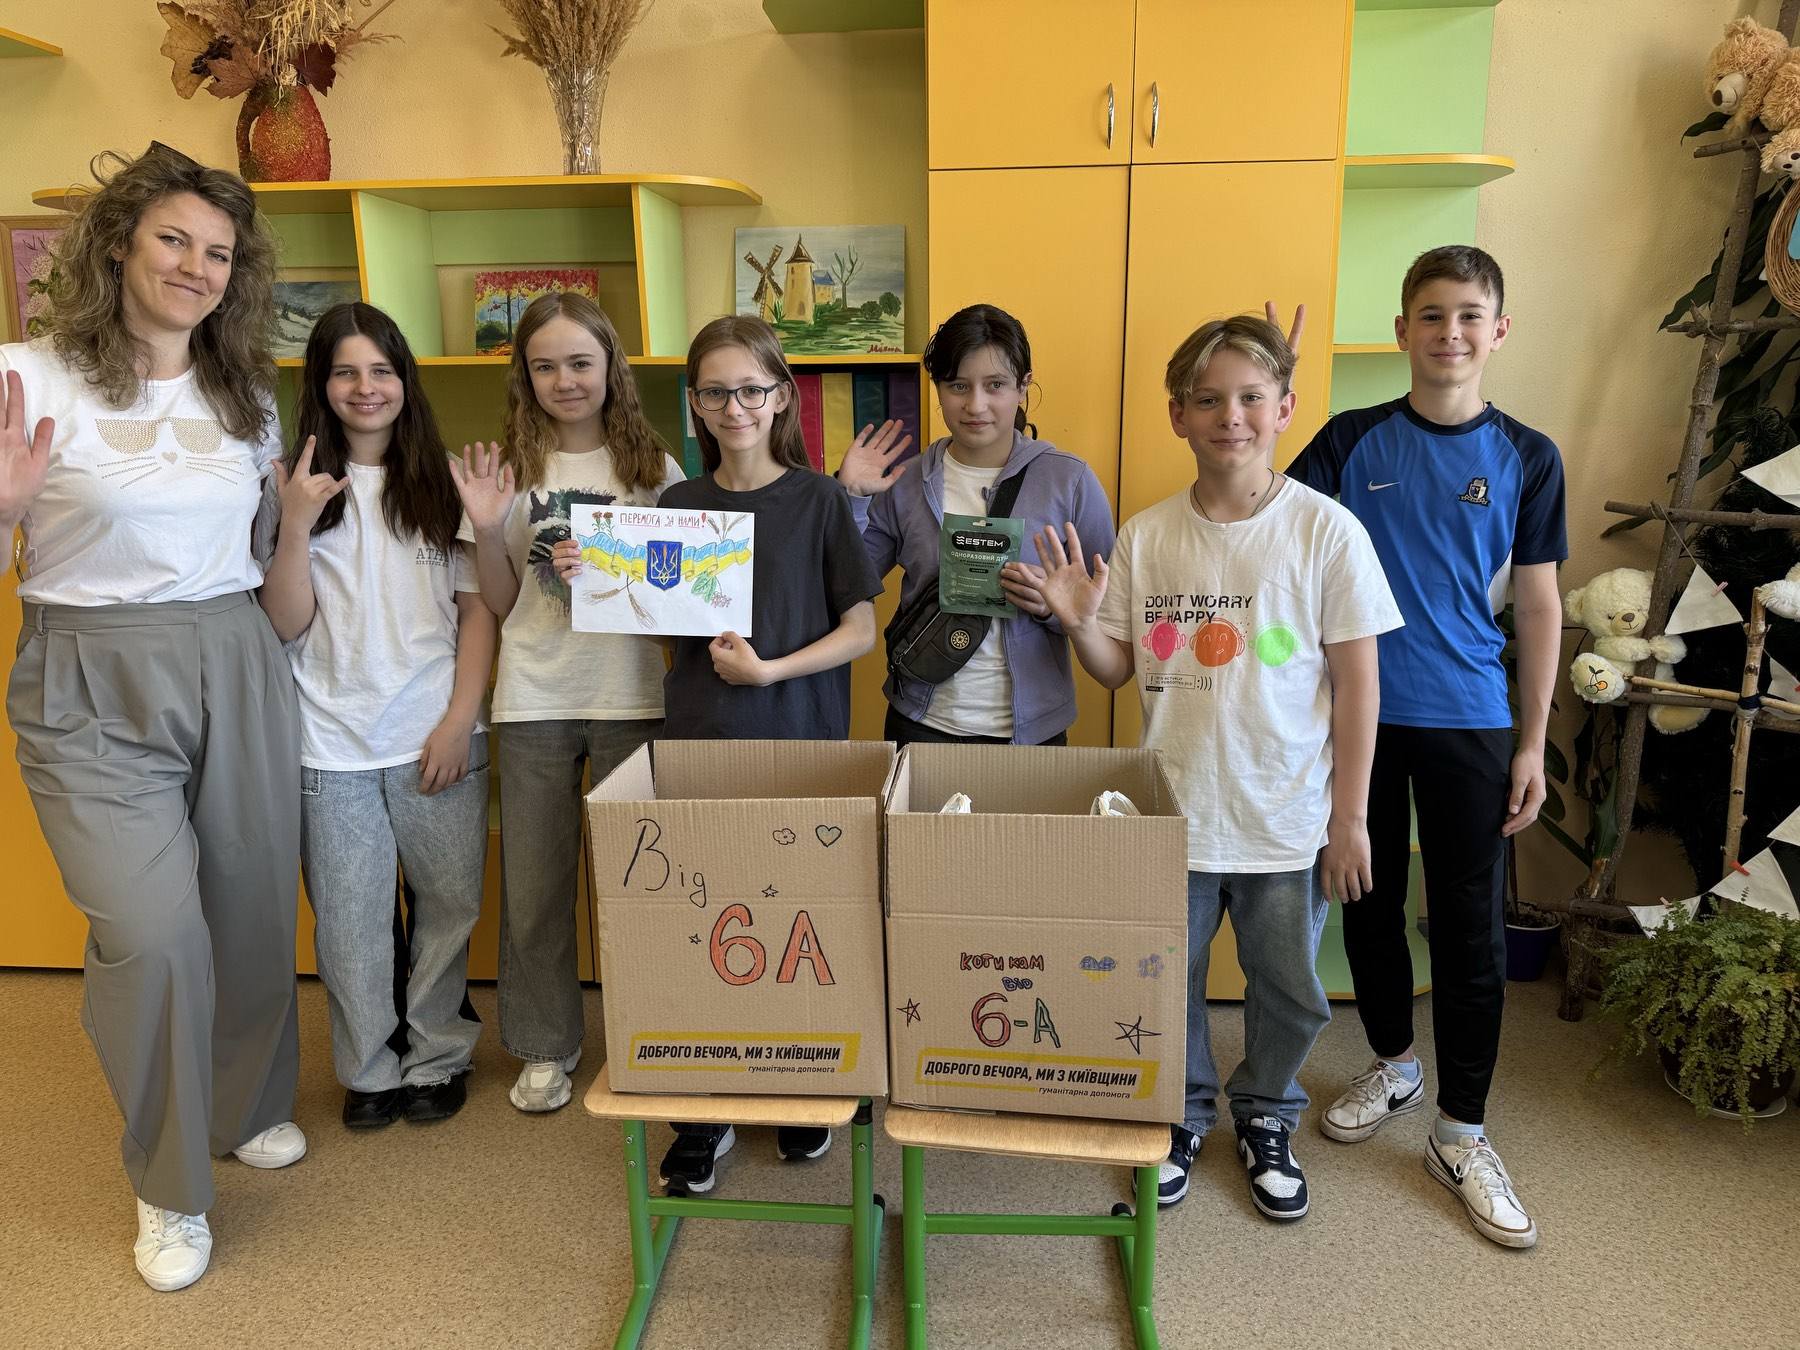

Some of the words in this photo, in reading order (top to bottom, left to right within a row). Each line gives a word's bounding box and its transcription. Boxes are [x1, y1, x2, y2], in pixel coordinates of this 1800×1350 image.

[619, 512, 660, 527] ПЕРЕМОГА
[965, 539, 1004, 547] ESTEM
[1190, 594, 1253, 609] WORRY
[1145, 611, 1162, 624] BE
[1167, 610, 1216, 624] HAPPY
[623, 818, 707, 908] Big
[709, 903, 836, 986] 6А
[971, 992, 1061, 1049] 6-А
[637, 1045, 692, 1060] ДОБРОГО
[694, 1045, 742, 1061] ВЕЧОРА,
[744, 1046, 763, 1060] МИ
[765, 1046, 773, 1060] З
[775, 1044, 841, 1062] КИЇВЩИНИ
[748, 1065, 796, 1074] гуманітарна
[797, 1066, 835, 1074] допомога
[924, 1061, 980, 1076] ДОБРОГО
[982, 1064, 1032, 1081] ВЕЧОРА,
[1035, 1068, 1056, 1081] МИ
[1057, 1069, 1066, 1082] З
[1067, 1068, 1138, 1087] КИЇВЩИНИ
[1038, 1087, 1088, 1097] гуманітарна
[1090, 1090, 1131, 1099] допомога
